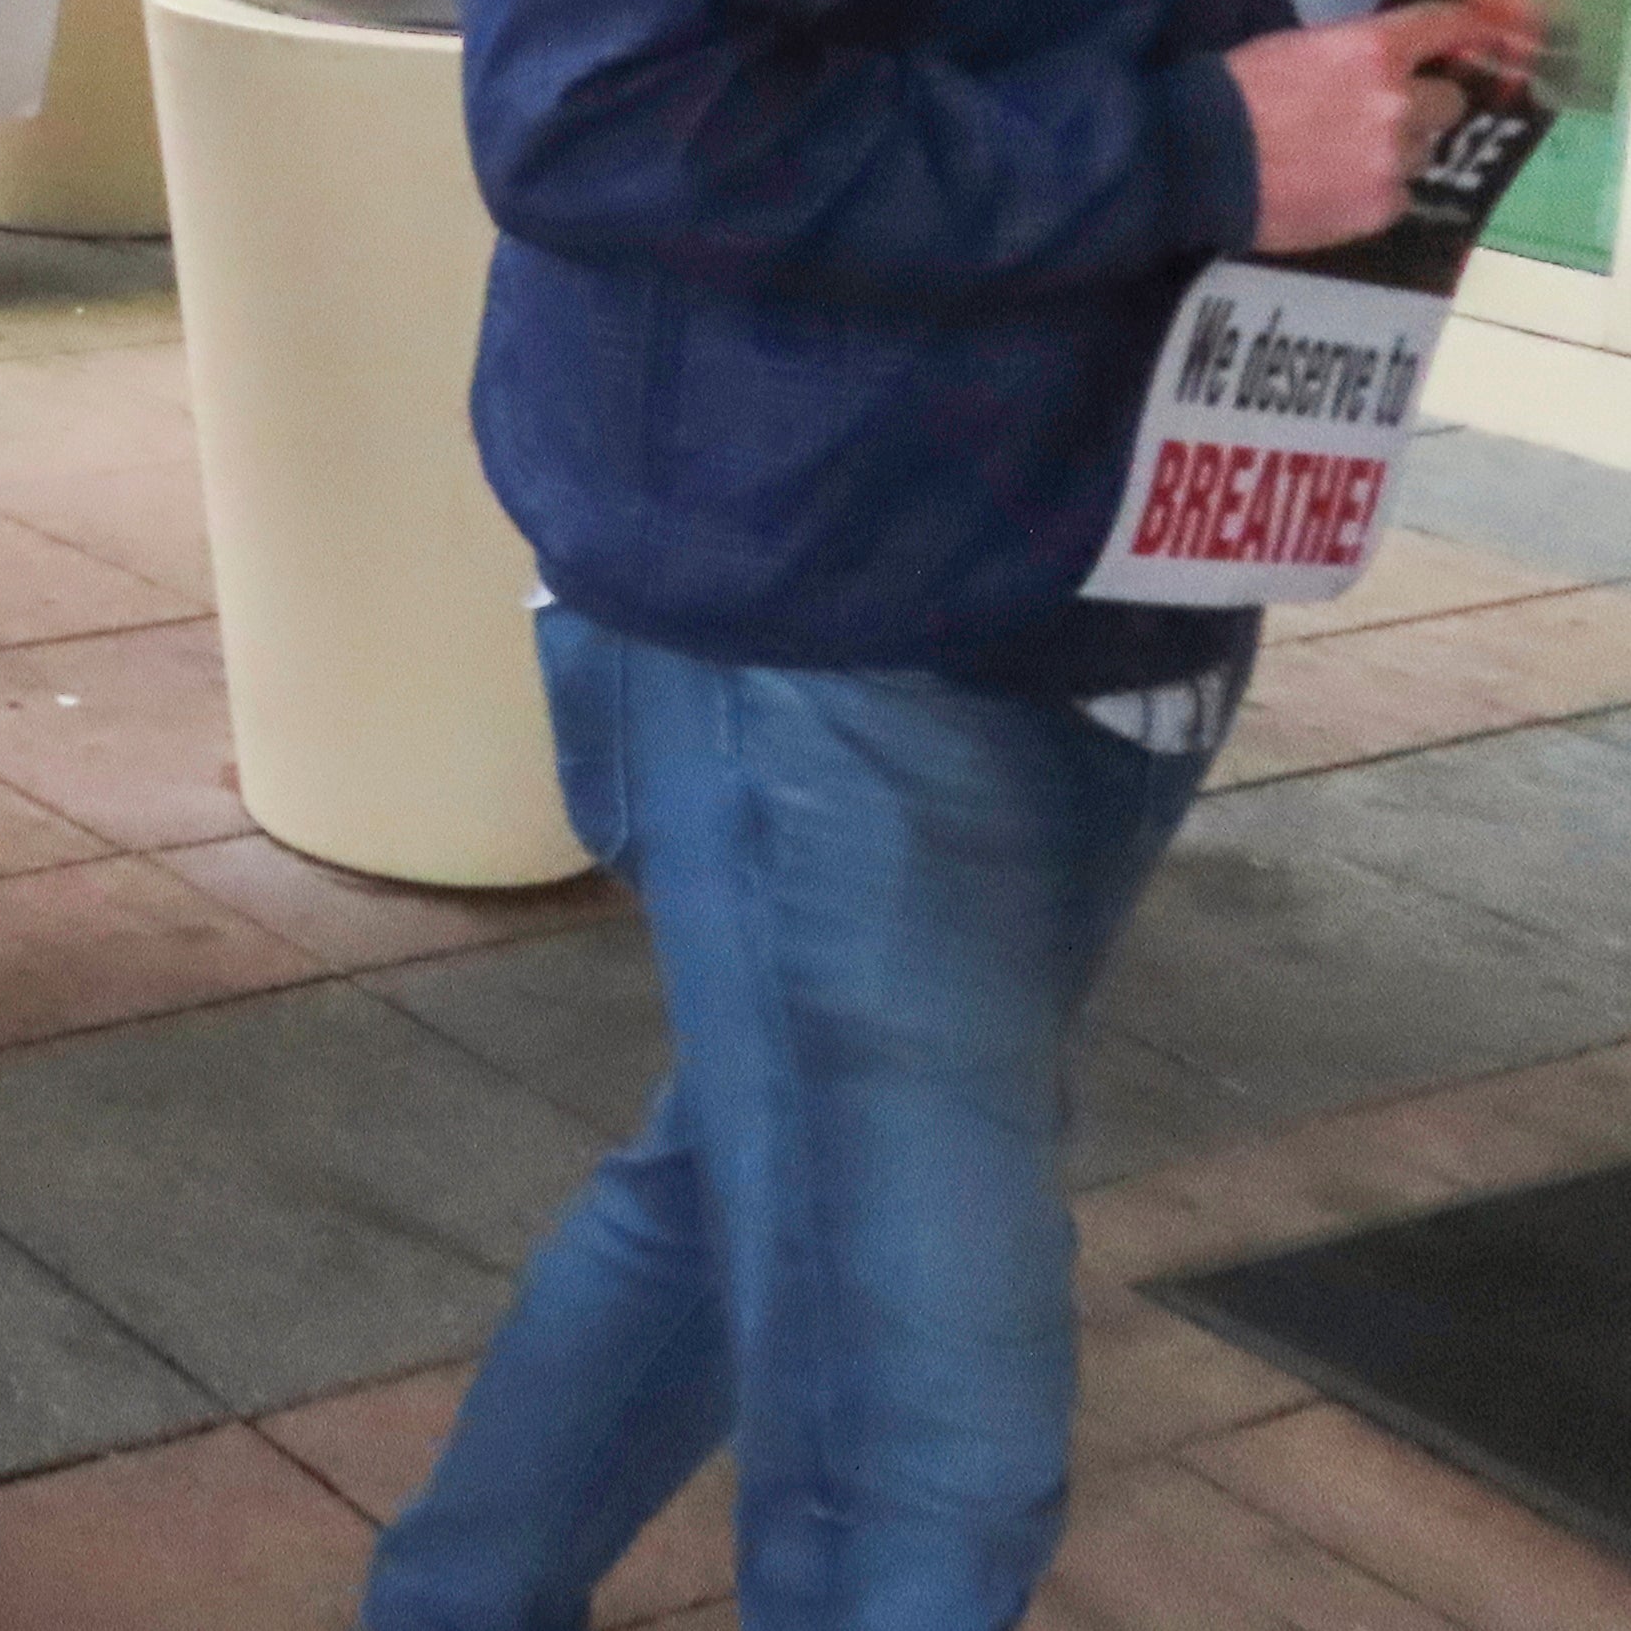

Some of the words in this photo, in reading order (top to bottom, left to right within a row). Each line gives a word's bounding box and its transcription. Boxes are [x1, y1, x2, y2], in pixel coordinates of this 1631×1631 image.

[1174, 294, 1240, 410] We
[1233, 306, 1378, 424] deserve
[1375, 334, 1421, 427] to
[1130, 439, 1390, 567] BREATHE!
